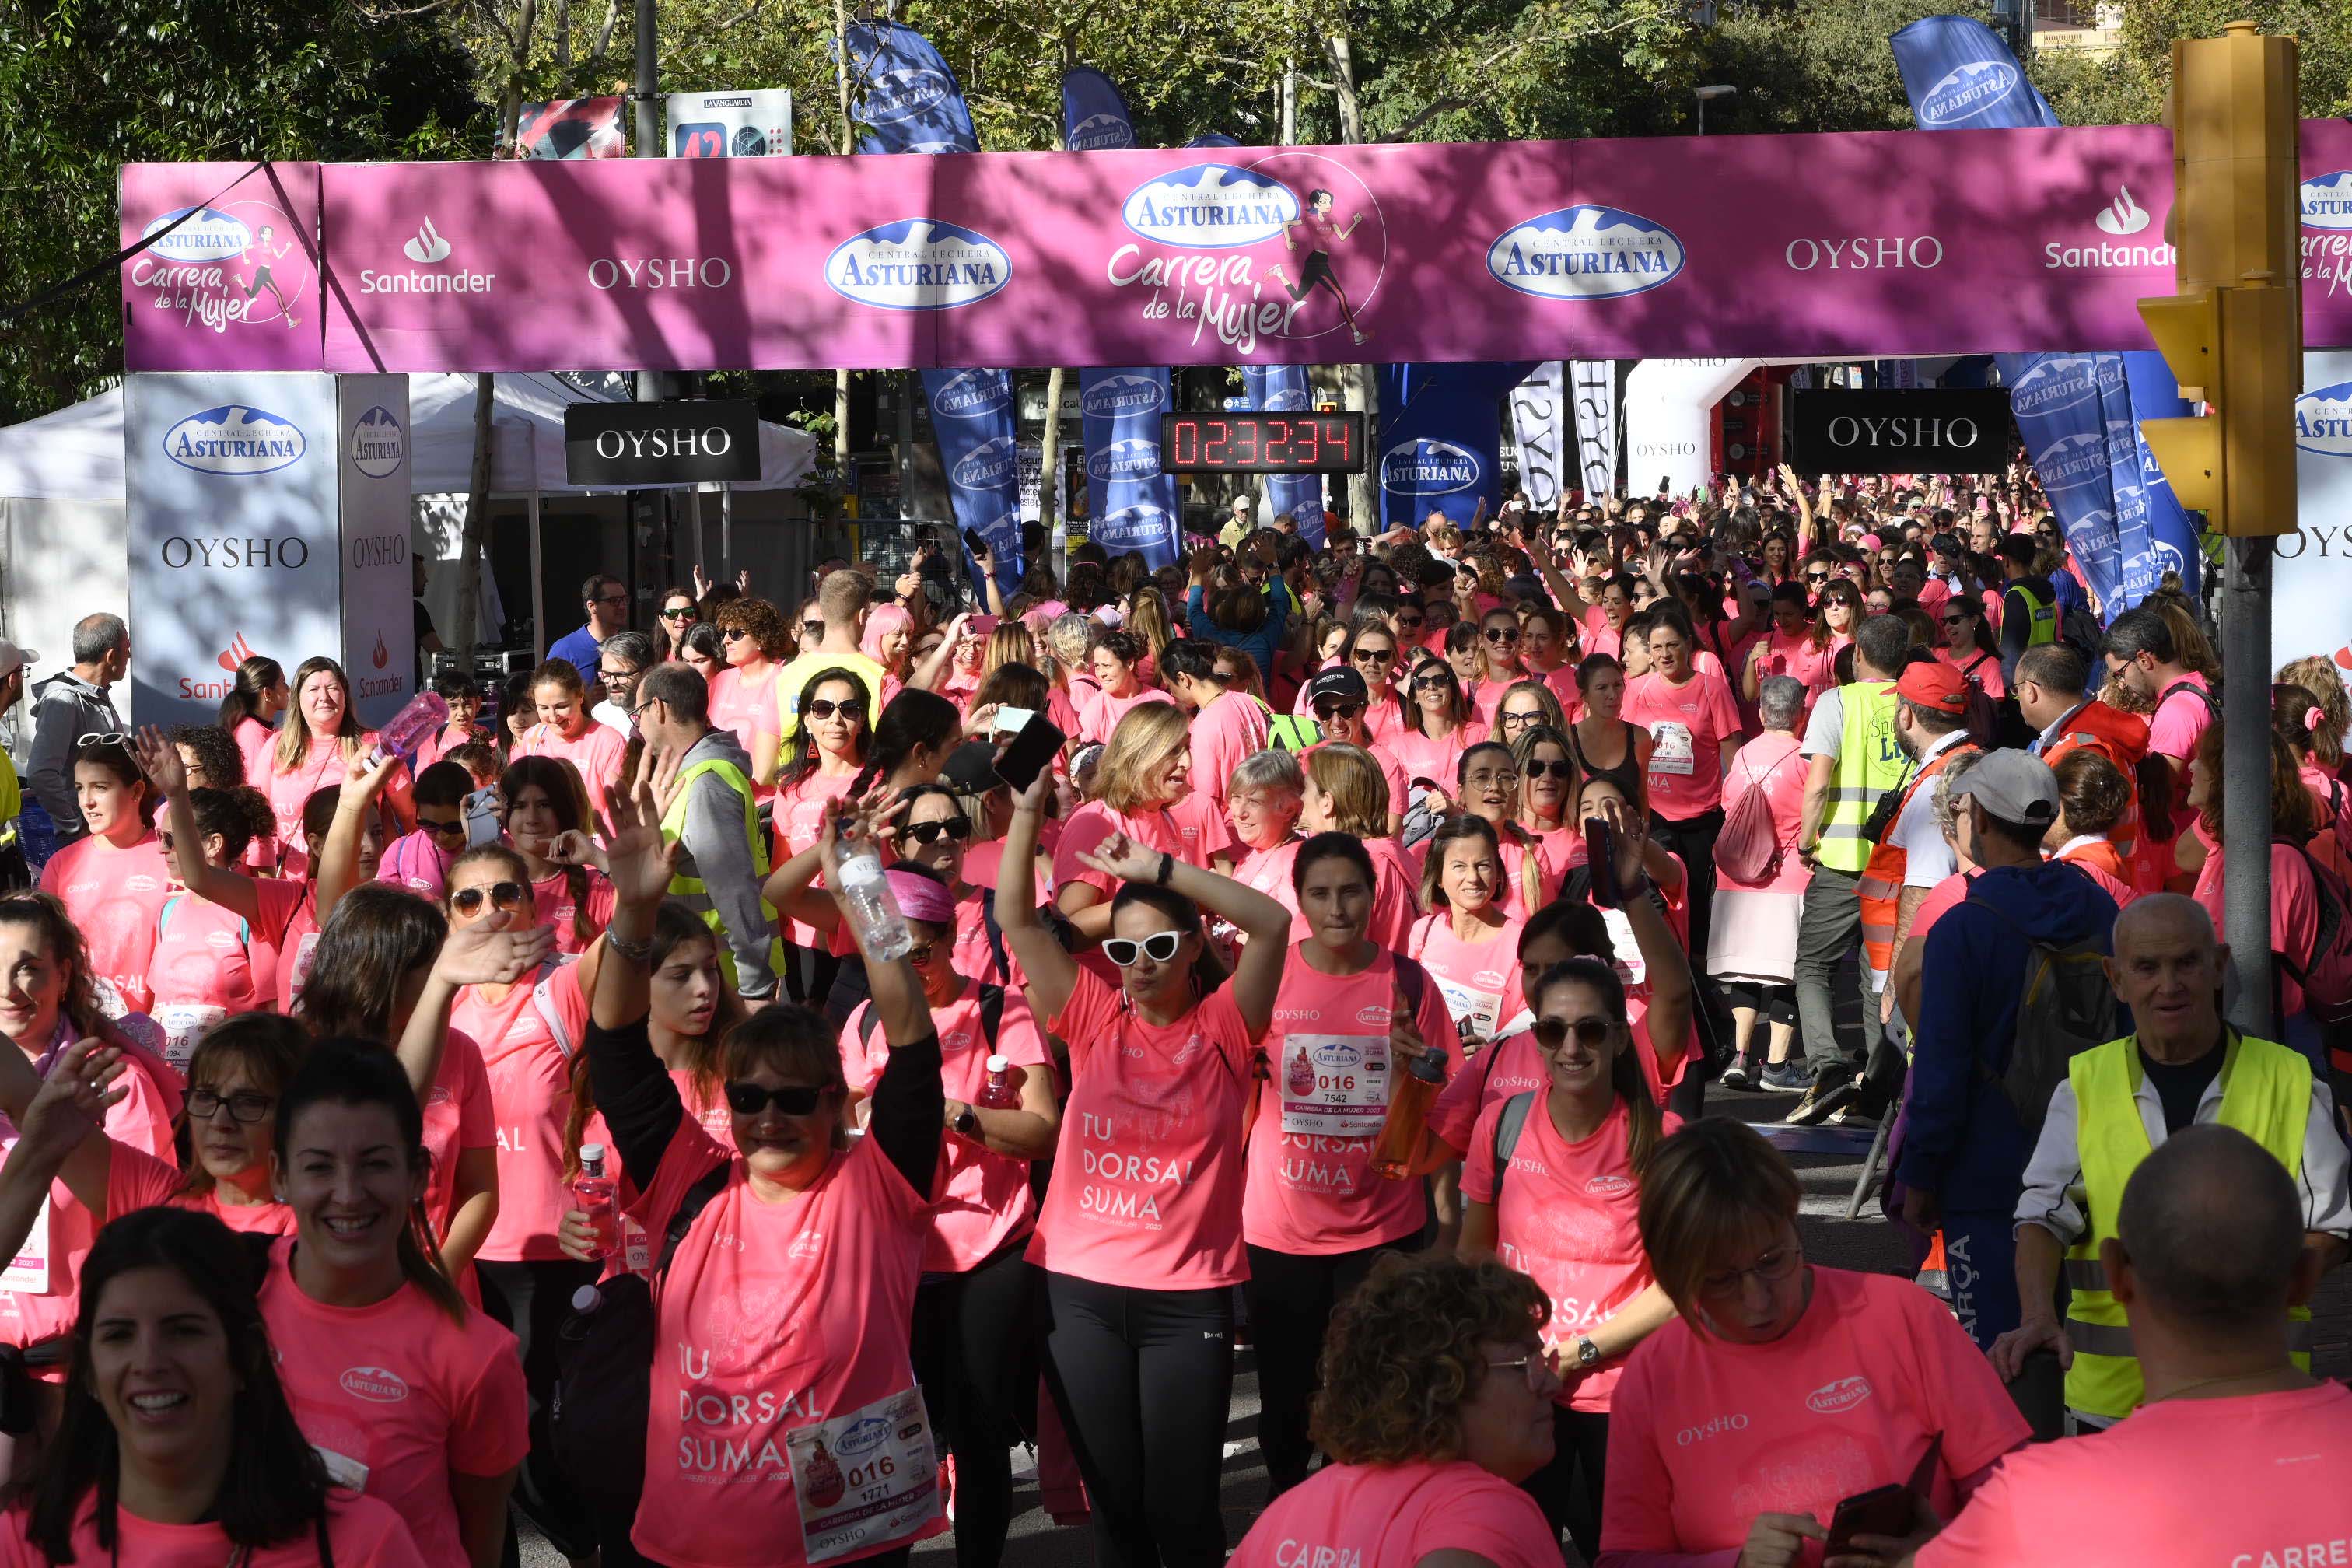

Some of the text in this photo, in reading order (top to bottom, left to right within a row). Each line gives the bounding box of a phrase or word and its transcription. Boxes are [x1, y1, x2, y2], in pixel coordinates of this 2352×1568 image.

[1164, 191, 1218, 201] CENTRAL
[1136, 195, 1284, 226] ASTURIANA
[151, 226, 243, 248] ASTURIANA
[1531, 236, 1663, 248] CENTRAL LECHERA
[868, 249, 991, 259] CENTRAL LECHERA
[1108, 243, 1252, 287] Carrera
[1502, 241, 1670, 277] ASTURIANA
[1786, 236, 1944, 270] OYSHO
[131, 258, 223, 288] Carrera
[359, 268, 495, 293] Santander
[588, 257, 731, 289] OYSHO
[839, 253, 998, 286] ASTURIANA
[154, 285, 258, 333] de la Mujer
[1143, 285, 1307, 355] de la Mujer
[175, 431, 296, 457] ASTURIANA
[196, 429, 291, 437] CENTRAL LECHERA
[596, 427, 731, 459] OYSHO
[1175, 422, 1349, 464] 02:32:34
[1828, 416, 1979, 449] OYSHO
[355, 432, 401, 460] ASTURIANA
[1636, 442, 1696, 457] OYSHO
[1384, 462, 1472, 484] ASTURIANA
[161, 537, 309, 569] OYSHO
[353, 534, 404, 569] OYSHO
[359, 674, 403, 698] Santander
[274, 802, 295, 816] TU
[1274, 1009, 1320, 1020] OYSHO
[1316, 1052, 1358, 1063] ASTURIANA
[1318, 1076, 1355, 1090] 016
[1493, 1076, 1541, 1089] OYSHO
[1294, 1104, 1322, 1114] CARRERA
[1324, 1094, 1347, 1104] 7542
[1082, 1111, 1112, 1141] TU
[1292, 1117, 1323, 1128] OYSHO
[1083, 1149, 1195, 1185] DORSAL
[1080, 1185, 1160, 1220] SUMA
[345, 1374, 402, 1398] ASTURIANA
[1812, 1384, 1869, 1410] ASTURIANA
[679, 1386, 823, 1425] DORSAL
[1676, 1413, 1749, 1446] OYSHO
[678, 1437, 785, 1472] SUMA
[767, 1472, 790, 1481] 2023
[848, 1456, 894, 1488] 016
[861, 1483, 891, 1502] 1771
[819, 1528, 866, 1549] OYSHO
